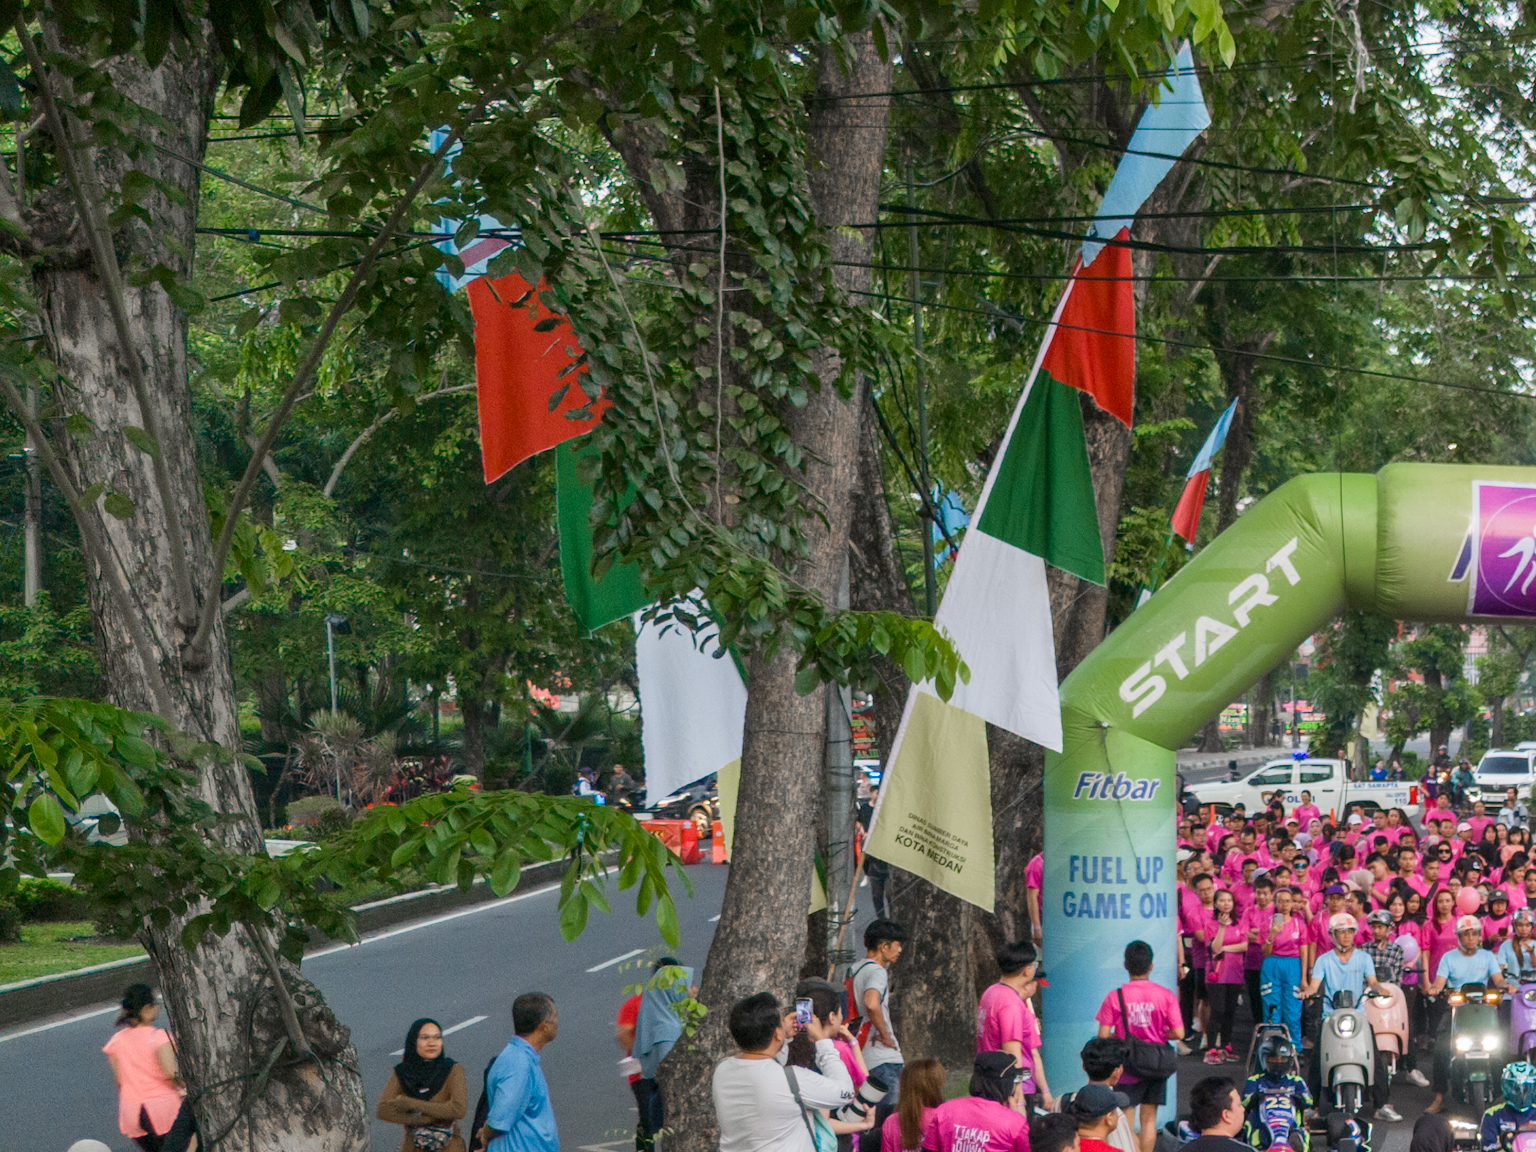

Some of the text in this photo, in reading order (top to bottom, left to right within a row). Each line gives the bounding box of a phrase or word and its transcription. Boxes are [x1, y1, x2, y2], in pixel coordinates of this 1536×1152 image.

[1119, 537, 1301, 719] START
[1073, 771, 1160, 800] Fitbar
[895, 833, 963, 874] KOTA MEDAN
[951, 834, 969, 848] DAYA
[1069, 855, 1164, 885] FUEL UP
[1063, 891, 1167, 919] GAME ON
[1266, 1097, 1292, 1109] 23
